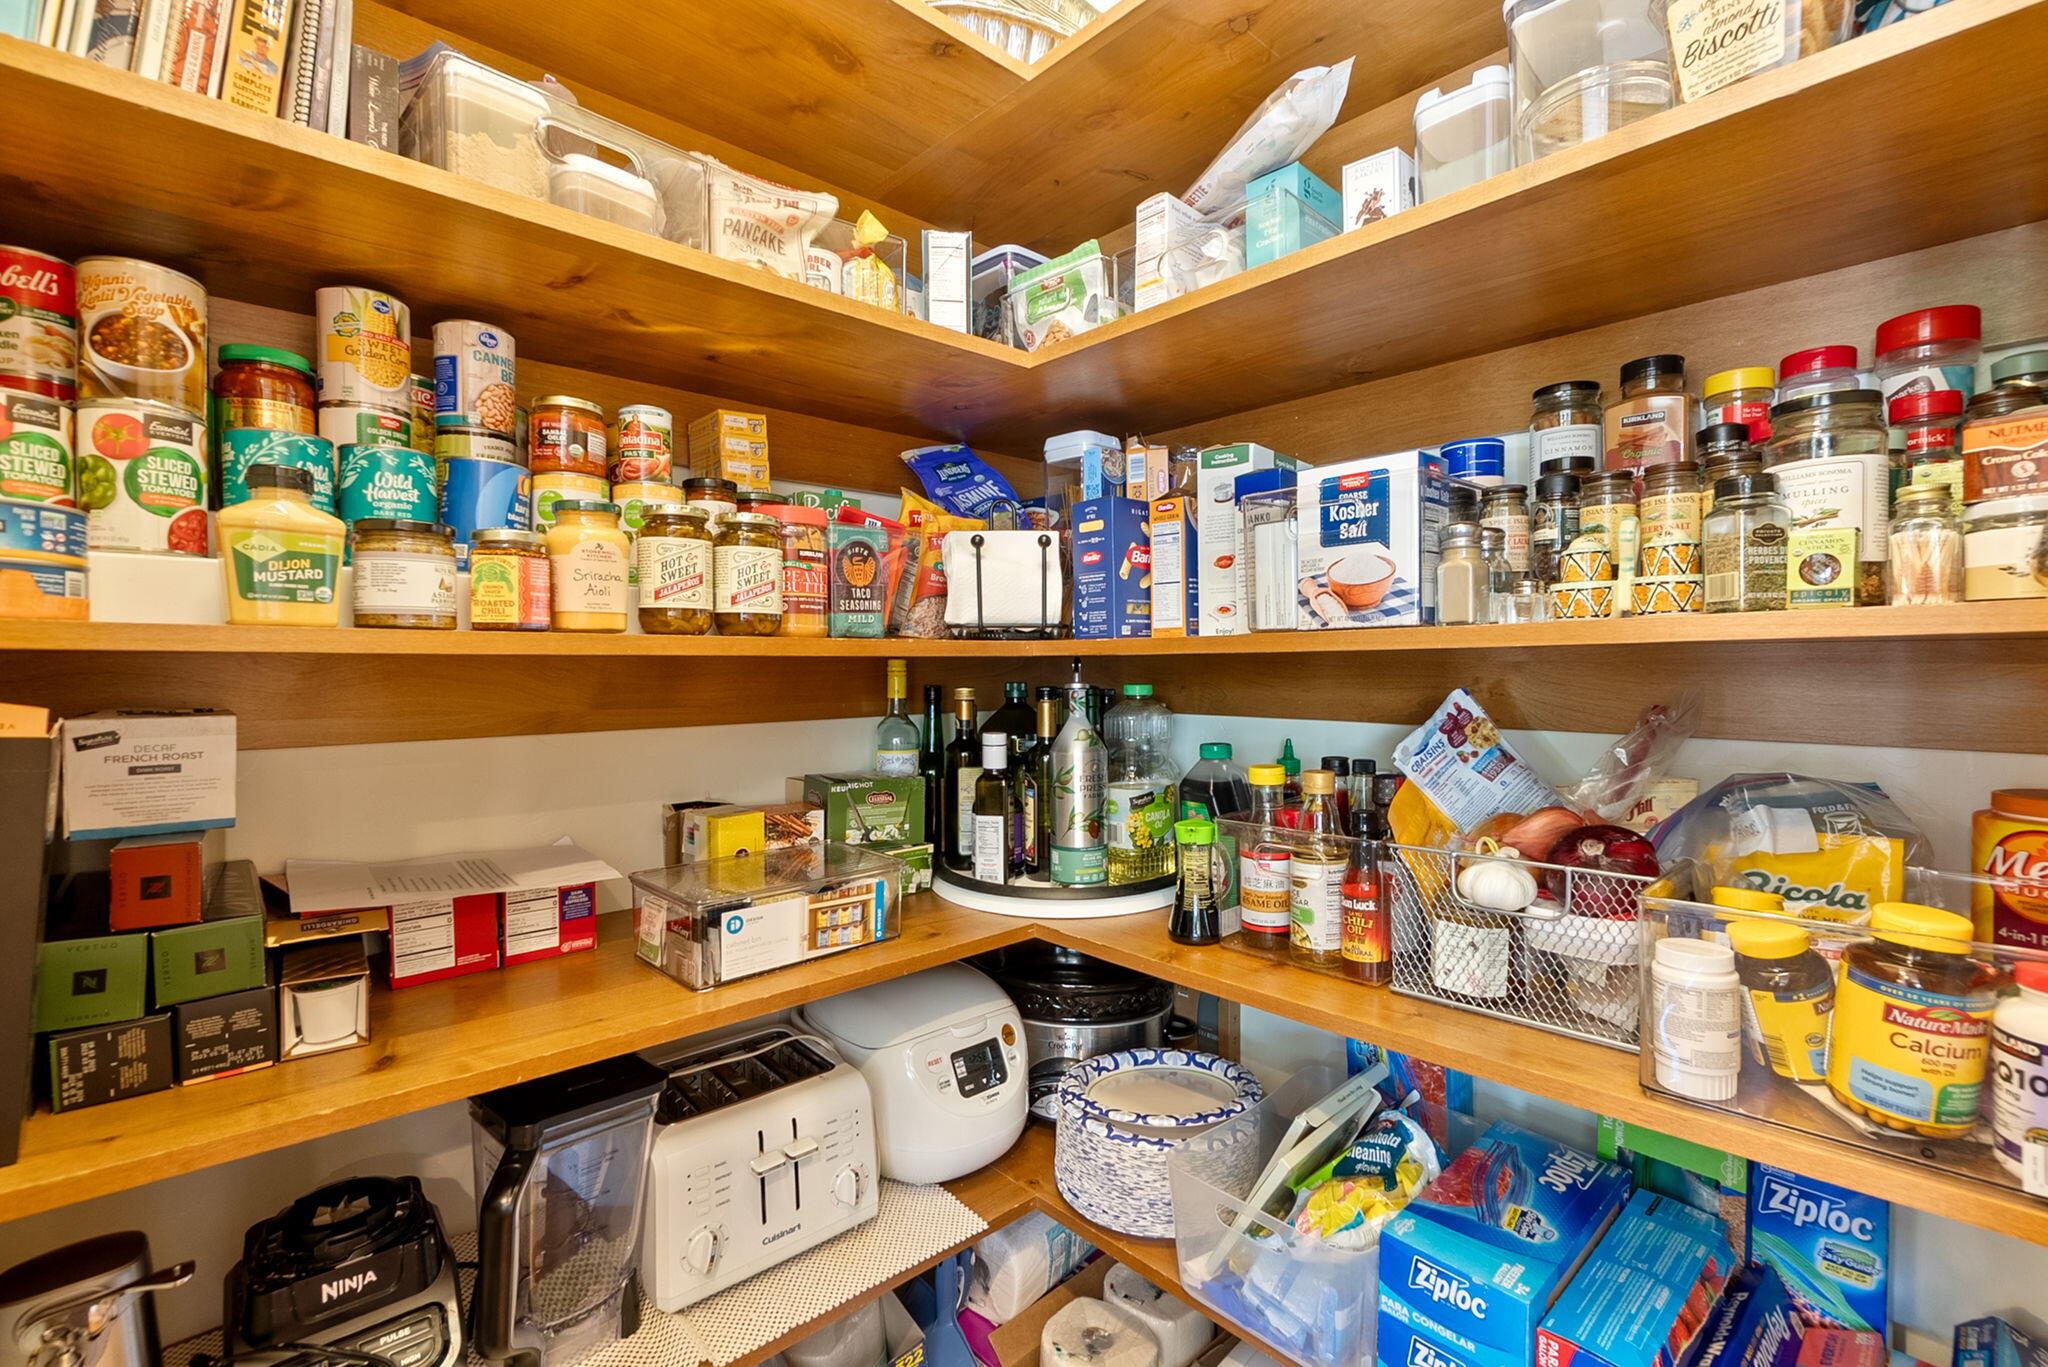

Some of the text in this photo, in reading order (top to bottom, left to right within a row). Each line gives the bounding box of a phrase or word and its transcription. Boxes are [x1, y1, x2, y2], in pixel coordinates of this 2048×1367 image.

[1703, 4, 1753, 36] almond
[1682, 1, 1781, 68] Biscotti
[722, 217, 787, 256] PANCAKE
[82, 272, 134, 291] Organic
[79, 286, 192, 311] Lentil Vegetable
[122, 301, 165, 320] Soup
[358, 338, 403, 356] SWEET
[345, 344, 409, 370] Golden Corn
[1891, 381, 1927, 401] market
[12, 403, 57, 420] Essential
[1622, 410, 1665, 425] KIRKLAND
[149, 421, 190, 436] Essential
[1988, 421, 2048, 438] NUTME
[1907, 434, 1945, 446] ormick
[8, 440, 60, 461] SLICED
[1544, 444, 1593, 455] CINNAMON
[1622, 448, 1662, 459] Organic
[0, 454, 66, 478] STEWED
[146, 456, 192, 474] SLICED
[1981, 453, 2021, 465] Crown
[2, 470, 65, 488] TOMATOES
[138, 469, 198, 491] STEWED
[937, 463, 971, 482] LUNDBERG
[373, 471, 413, 490] Wild
[140, 484, 196, 499] TOMATOES
[363, 486, 420, 504] Harvest
[949, 480, 1007, 513] JASMINE
[1339, 490, 1369, 501] COARSE
[1782, 486, 1850, 500] MULLING
[373, 501, 413, 510] organic
[1131, 508, 1149, 516] RIGAT
[1329, 502, 1380, 522] Kosher
[1248, 512, 1271, 522] ANKO
[1339, 520, 1368, 539] Salt
[1642, 523, 1666, 533] ELERY
[242, 543, 278, 552] CADIA
[1799, 538, 1844, 546] CINNAMON
[847, 547, 868, 557] SIETE
[1748, 546, 1778, 555] HERBES
[268, 559, 311, 571] DIJON
[660, 553, 698, 573] HOT &
[1748, 556, 1786, 564] PROVENC
[253, 569, 323, 582] MUSTARD
[573, 568, 623, 582] Sriracha
[660, 563, 698, 584] SWEET
[737, 560, 772, 578] HOT &
[657, 575, 702, 598] JALAPEÑOS
[736, 570, 771, 590] SWEET
[782, 582, 825, 593] BUTTE
[584, 583, 611, 596] Aioli
[734, 582, 774, 603] JALAPEÑOS
[851, 588, 871, 599] TACO
[1793, 589, 1849, 598] spicely
[473, 600, 515, 608] ROASTED
[840, 600, 881, 611] SEASONING
[847, 615, 875, 623] MILD
[1215, 628, 1235, 636] Enjoy!
[134, 744, 177, 753] DECAF
[104, 751, 204, 764] FRENCH ROAST
[1409, 739, 1448, 774] CRAISINS
[1485, 761, 1506, 781] 1930
[1080, 775, 1104, 783] FRES
[831, 781, 874, 793] KEURIG HOT
[1145, 809, 1171, 822] CANOLA
[1812, 804, 1836, 815] FOLD
[1742, 868, 1867, 911] Ricola
[507, 904, 532, 914] Calories
[1242, 895, 1290, 909] ESAME OIL
[1353, 899, 1376, 911] Luck
[302, 916, 359, 931] GHIRARDELLI
[395, 923, 421, 935] Calories
[1344, 915, 1374, 929] CHILI
[1347, 925, 1365, 936] OIL
[1999, 927, 2038, 945] 4-in-1
[67, 942, 118, 952] VERTUO
[1880, 985, 1904, 997] OVER
[1922, 996, 1950, 1007] YEARS
[1888, 1008, 1951, 1034] Nature
[1889, 1031, 1982, 1061] Calcium
[928, 1057, 943, 1067] RESET
[1921, 1057, 1957, 1070] 600 mg
[1921, 1067, 1939, 1075] with
[1861, 1068, 1919, 1094] Helps support
[1861, 1075, 1886, 1092] strong
[1880, 1097, 1923, 1118] SOFTGELS
[1355, 1163, 1381, 1175] gloves
[1539, 1149, 1598, 1194] Ziploc
[1769, 1181, 1873, 1241] Ziploc
[762, 1223, 802, 1246] Cuisinart
[321, 1269, 377, 1304] NINJA
[1414, 1261, 1488, 1319] Ziploc
[1381, 1294, 1477, 1353] PARA CONGELAR
[1720, 1291, 1749, 1342] Reynolds
[380, 1326, 411, 1346] PULSE
[401, 1352, 421, 1366] HIGH
